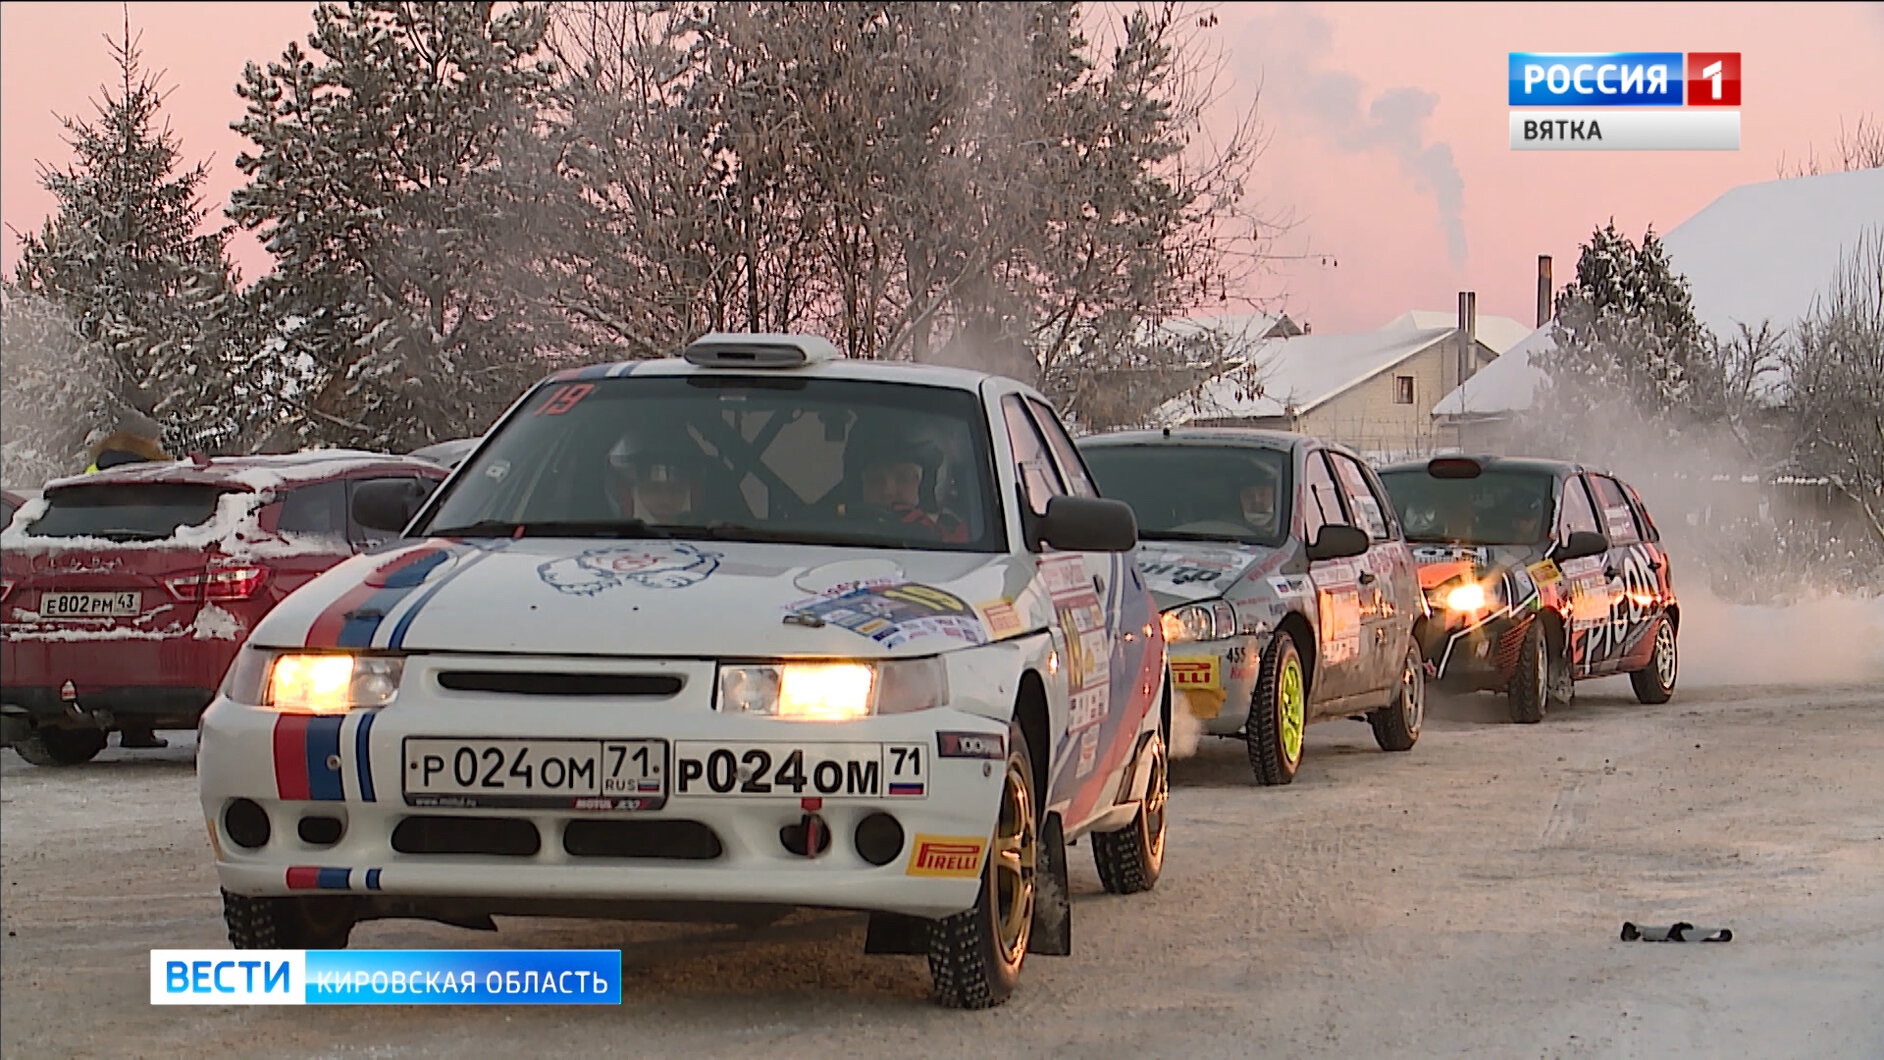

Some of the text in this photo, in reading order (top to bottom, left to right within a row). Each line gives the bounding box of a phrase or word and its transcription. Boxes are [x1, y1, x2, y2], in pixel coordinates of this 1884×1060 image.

[534, 383, 595, 416] 19
[47, 594, 134, 614] Е802РМ 43
[423, 745, 649, 789] Р024ОМ 71
[678, 747, 920, 795] Р024ОМ 71
[605, 778, 636, 791] RUS
[916, 841, 981, 870] PIRELLI
